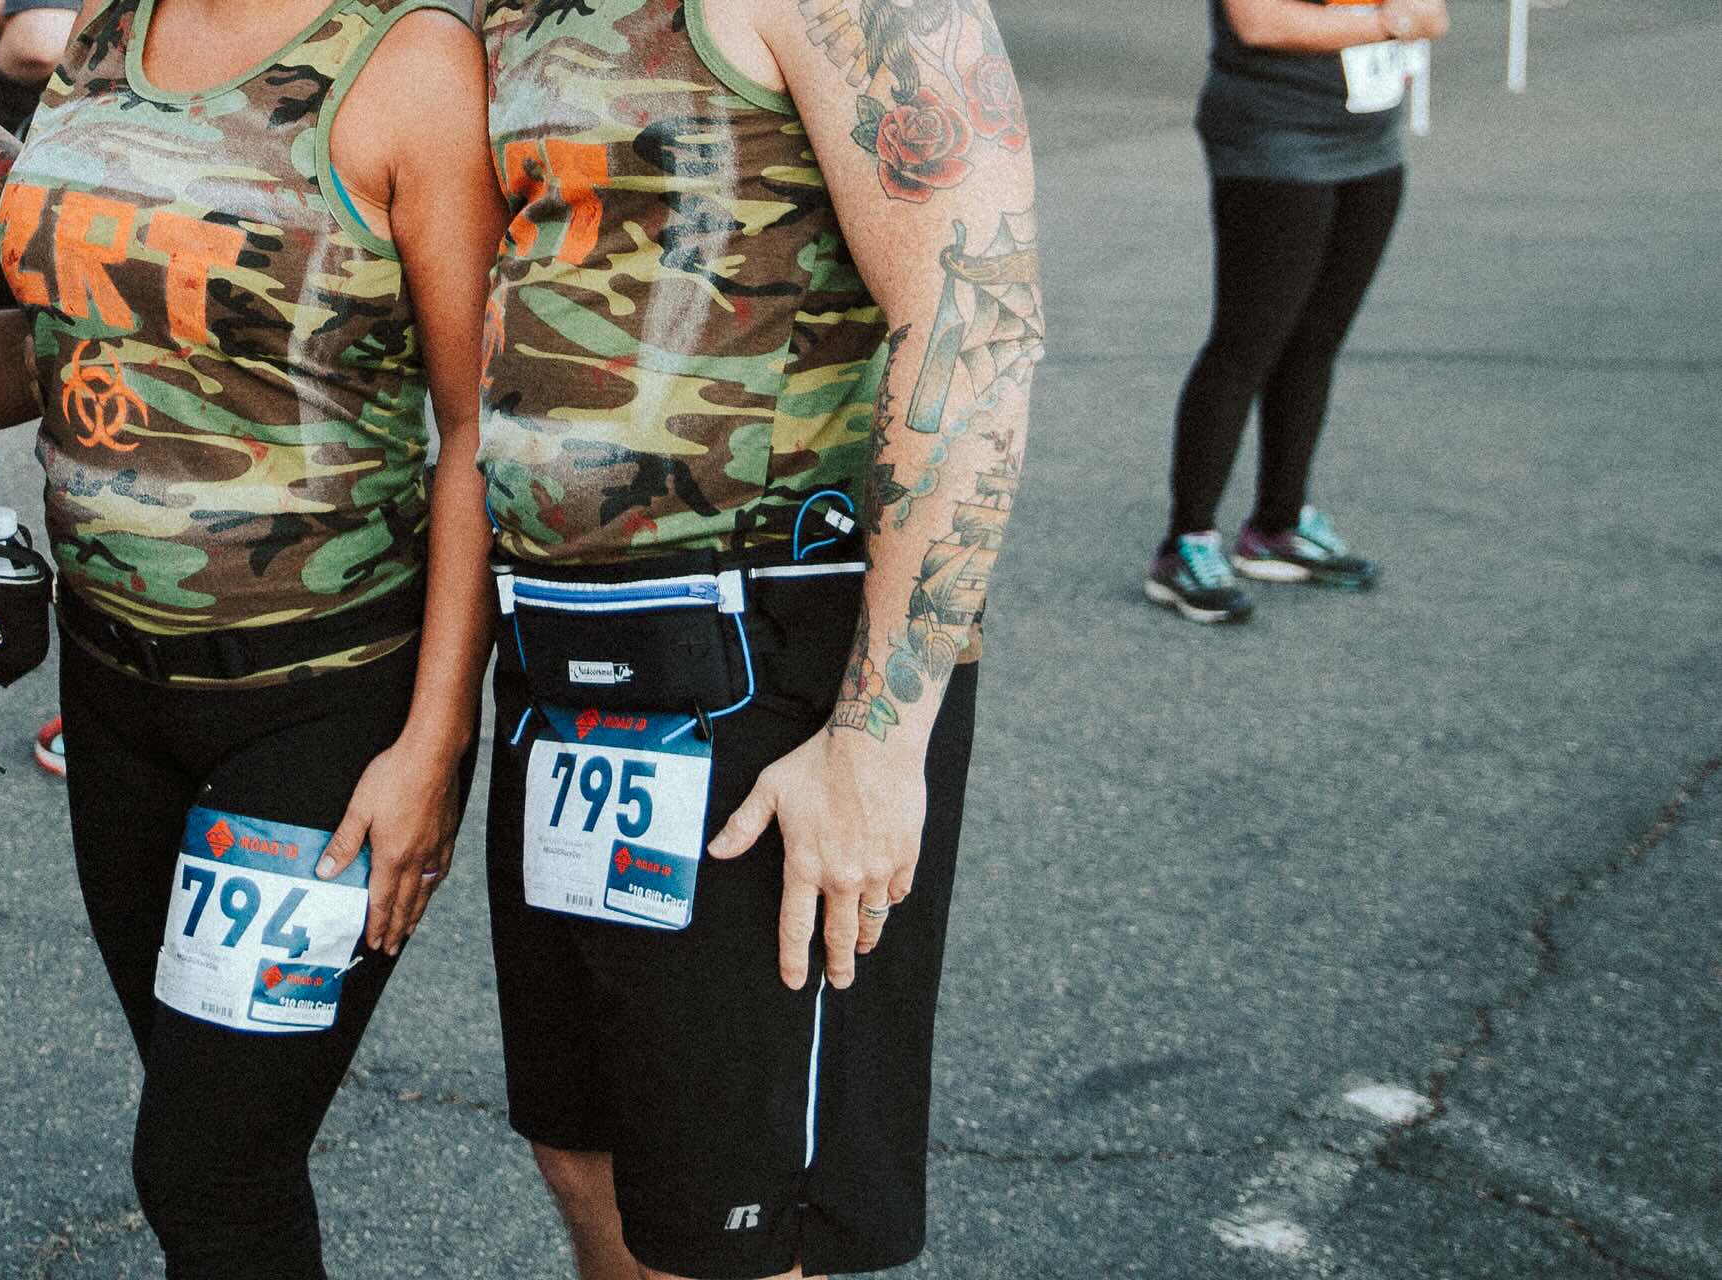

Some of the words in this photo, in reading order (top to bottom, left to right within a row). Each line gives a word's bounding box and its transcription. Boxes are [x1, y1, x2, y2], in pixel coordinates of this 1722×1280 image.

[549, 751, 657, 838] 795
[181, 864, 311, 959] 794
[644, 887, 662, 902] Gift
[663, 890, 688, 911] Card
